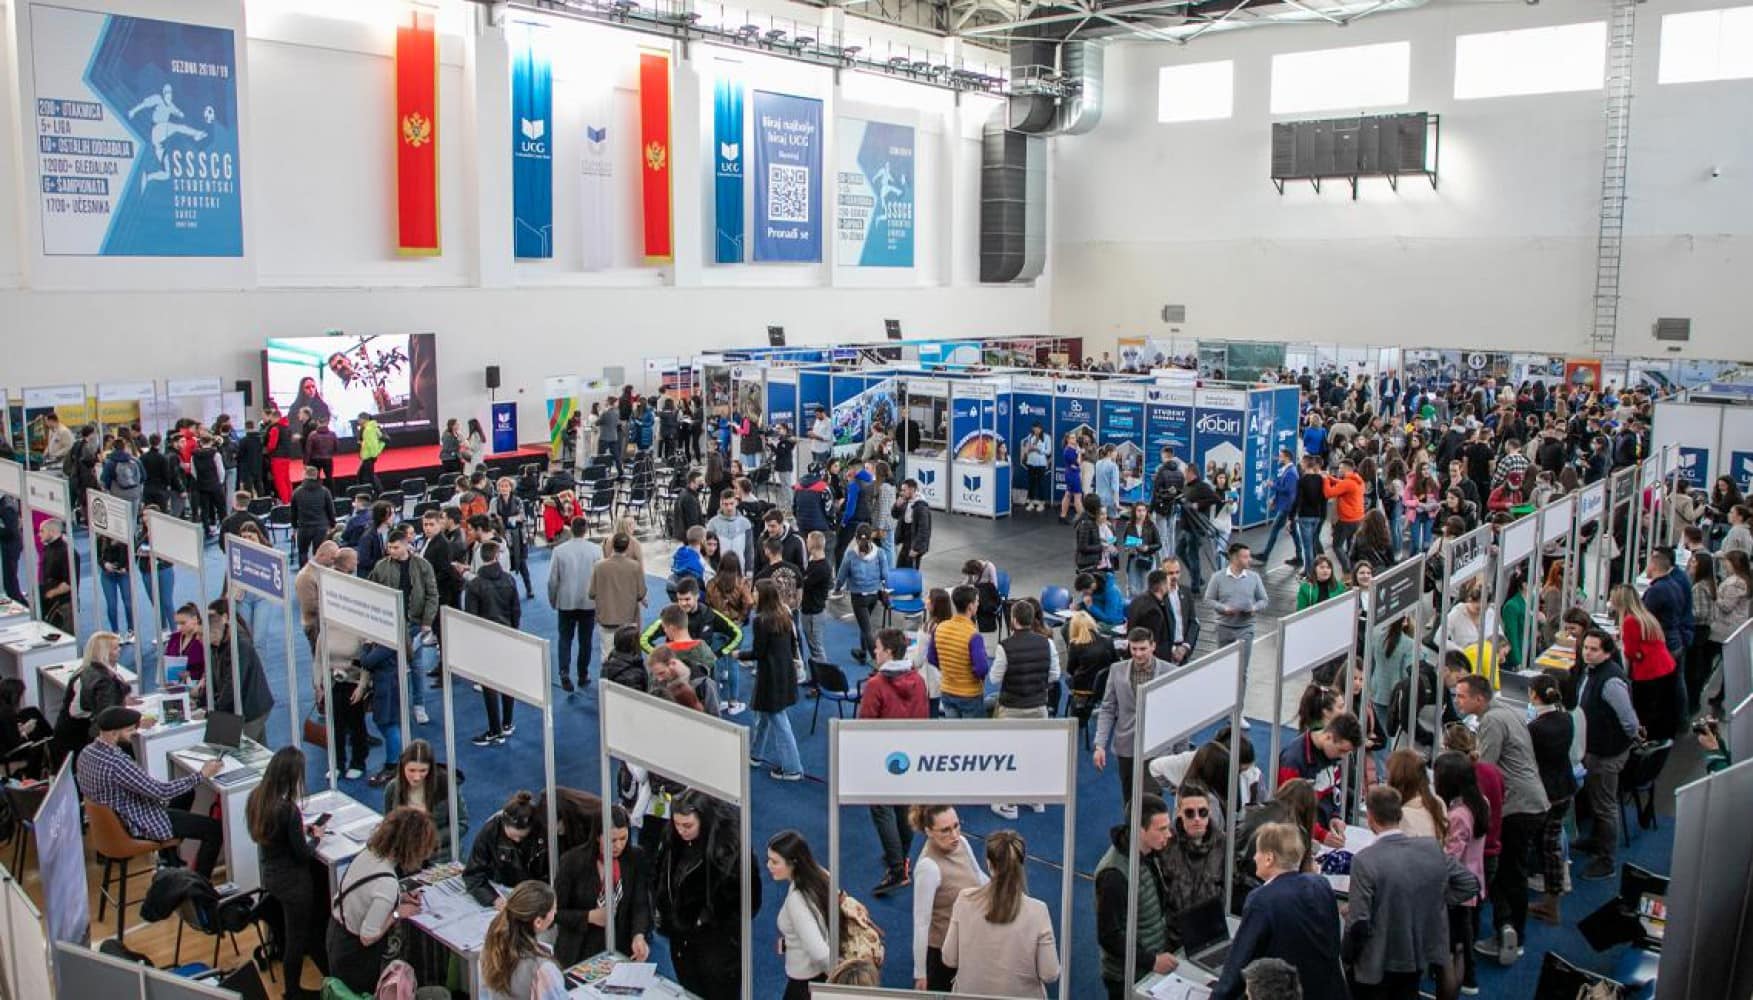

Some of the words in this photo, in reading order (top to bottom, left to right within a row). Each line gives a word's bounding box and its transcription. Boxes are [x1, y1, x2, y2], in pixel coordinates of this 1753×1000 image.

[54, 120, 71, 135] LIGA
[521, 142, 546, 153] UCG
[789, 134, 809, 147] UCG
[172, 149, 232, 180] SSSCG
[916, 754, 1017, 773] NESHVYL
